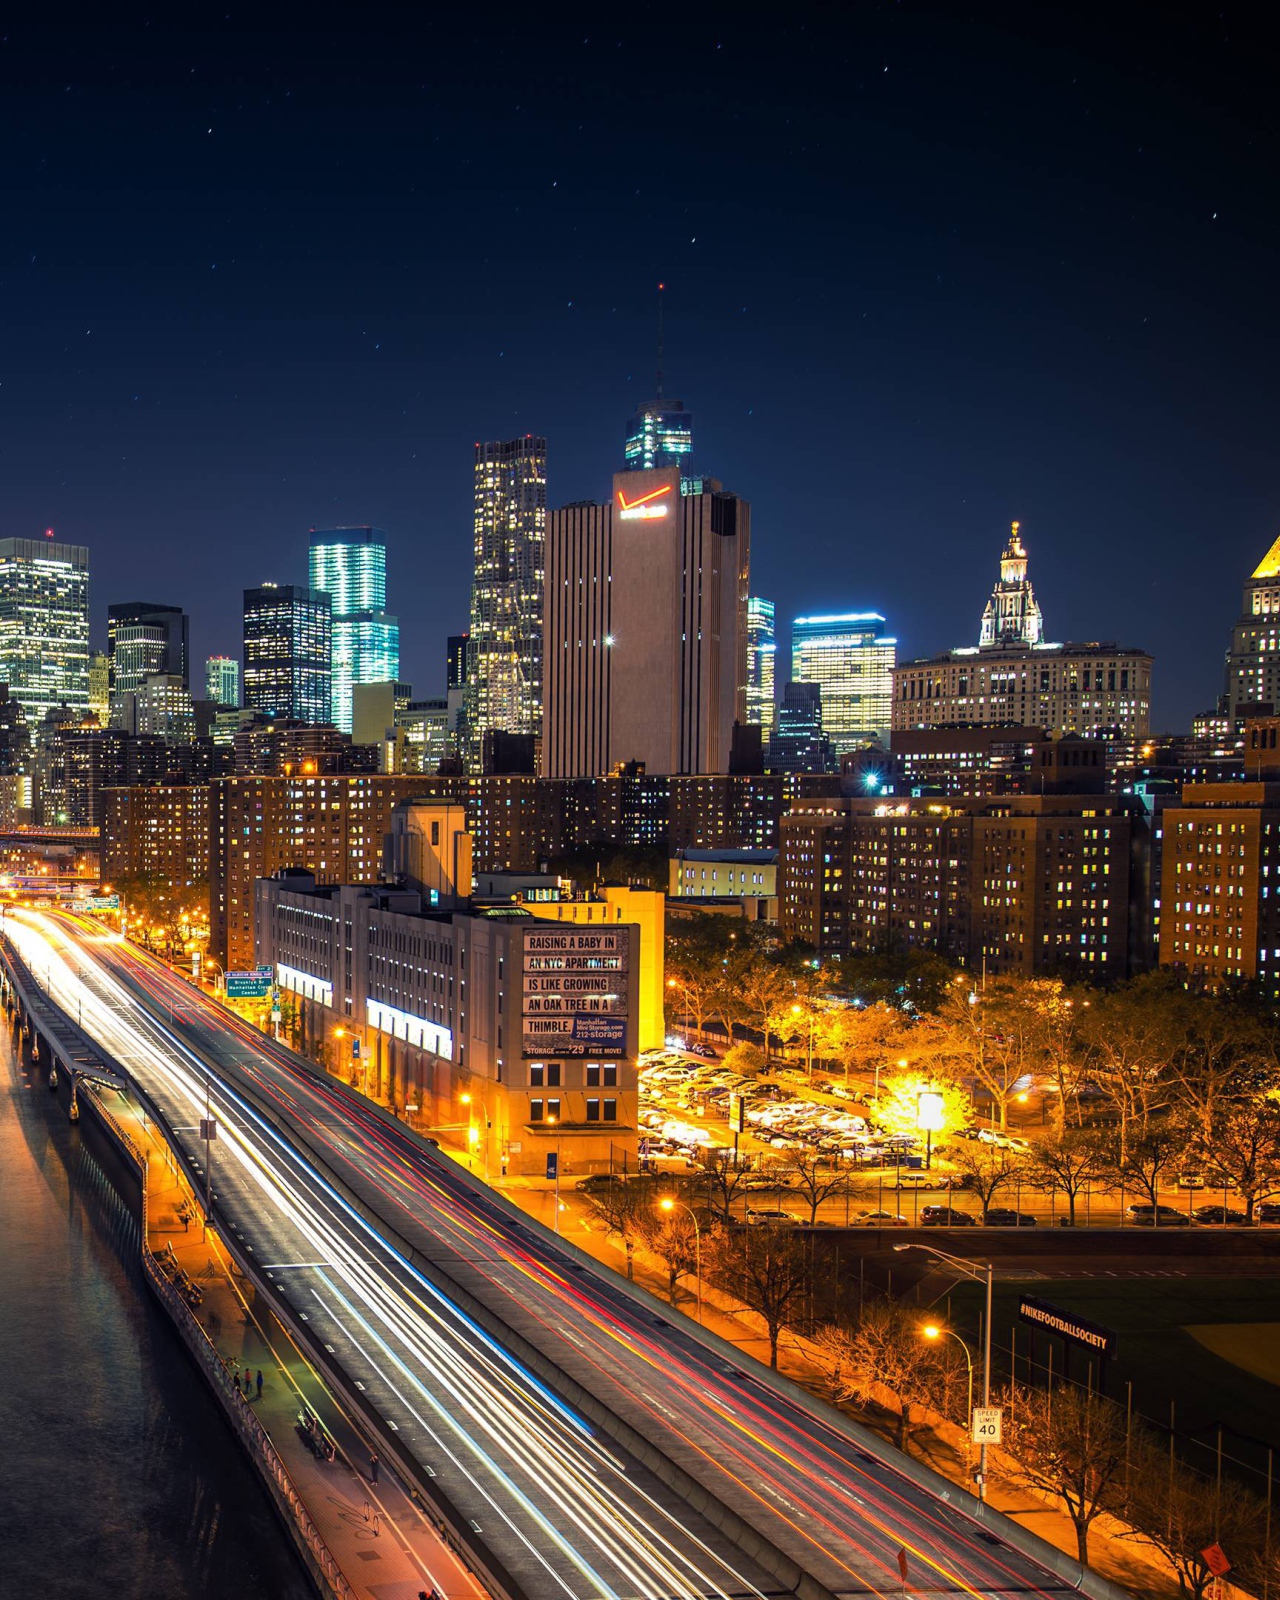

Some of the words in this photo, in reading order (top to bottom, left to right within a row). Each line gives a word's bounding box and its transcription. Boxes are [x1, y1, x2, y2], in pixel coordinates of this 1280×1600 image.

[529, 937, 567, 949] RAISING
[569, 937, 575, 948] A
[578, 937, 602, 949] BABY
[605, 937, 614, 948] IN
[529, 957, 541, 969] AN
[544, 957, 563, 969] NYC
[565, 957, 619, 969] APARTMENT
[528, 979, 538, 990] IS
[540, 979, 561, 990] LIKE
[563, 979, 607, 990] GROWING
[528, 999, 540, 1011] AN
[543, 999, 562, 1011] OAK
[565, 999, 587, 1011] TREE
[590, 999, 600, 1011] IN
[602, 999, 608, 1010] A
[528, 1021, 571, 1032] THIMBLE.
[576, 1031, 622, 1039] 212-storage
[527, 1047, 555, 1055] STORAGE
[568, 1044, 585, 1054] $29
[1020, 1303, 1107, 1349] #NIKEFOOTBALLSOCIETY
[979, 1424, 996, 1435] 40
